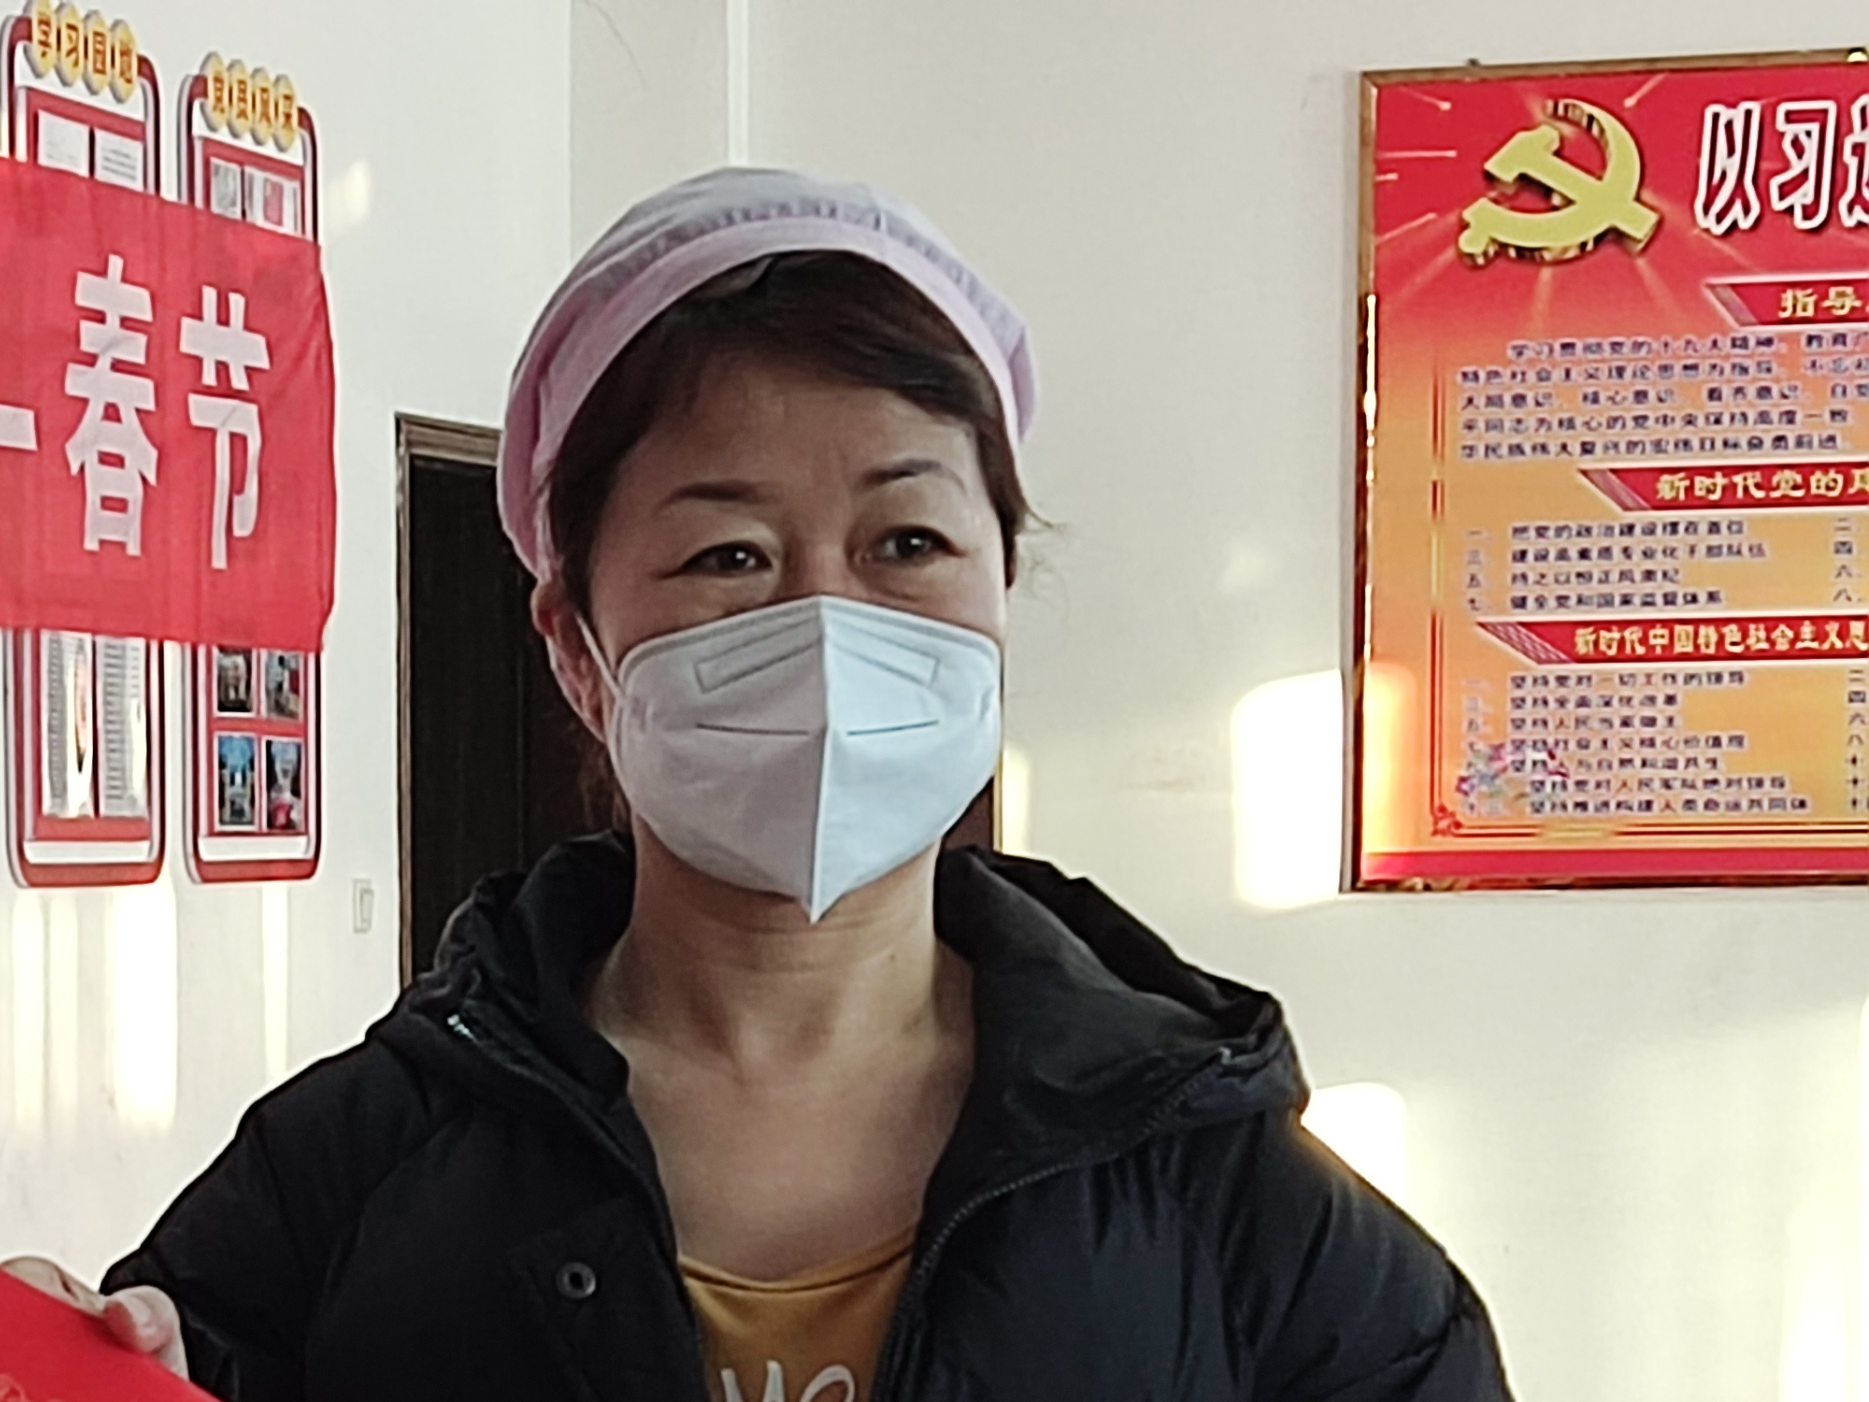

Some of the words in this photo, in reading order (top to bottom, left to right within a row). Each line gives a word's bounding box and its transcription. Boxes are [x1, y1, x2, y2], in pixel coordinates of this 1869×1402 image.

[36, 11, 134, 85] 学习园地
[211, 70, 295, 132] 党员风采
